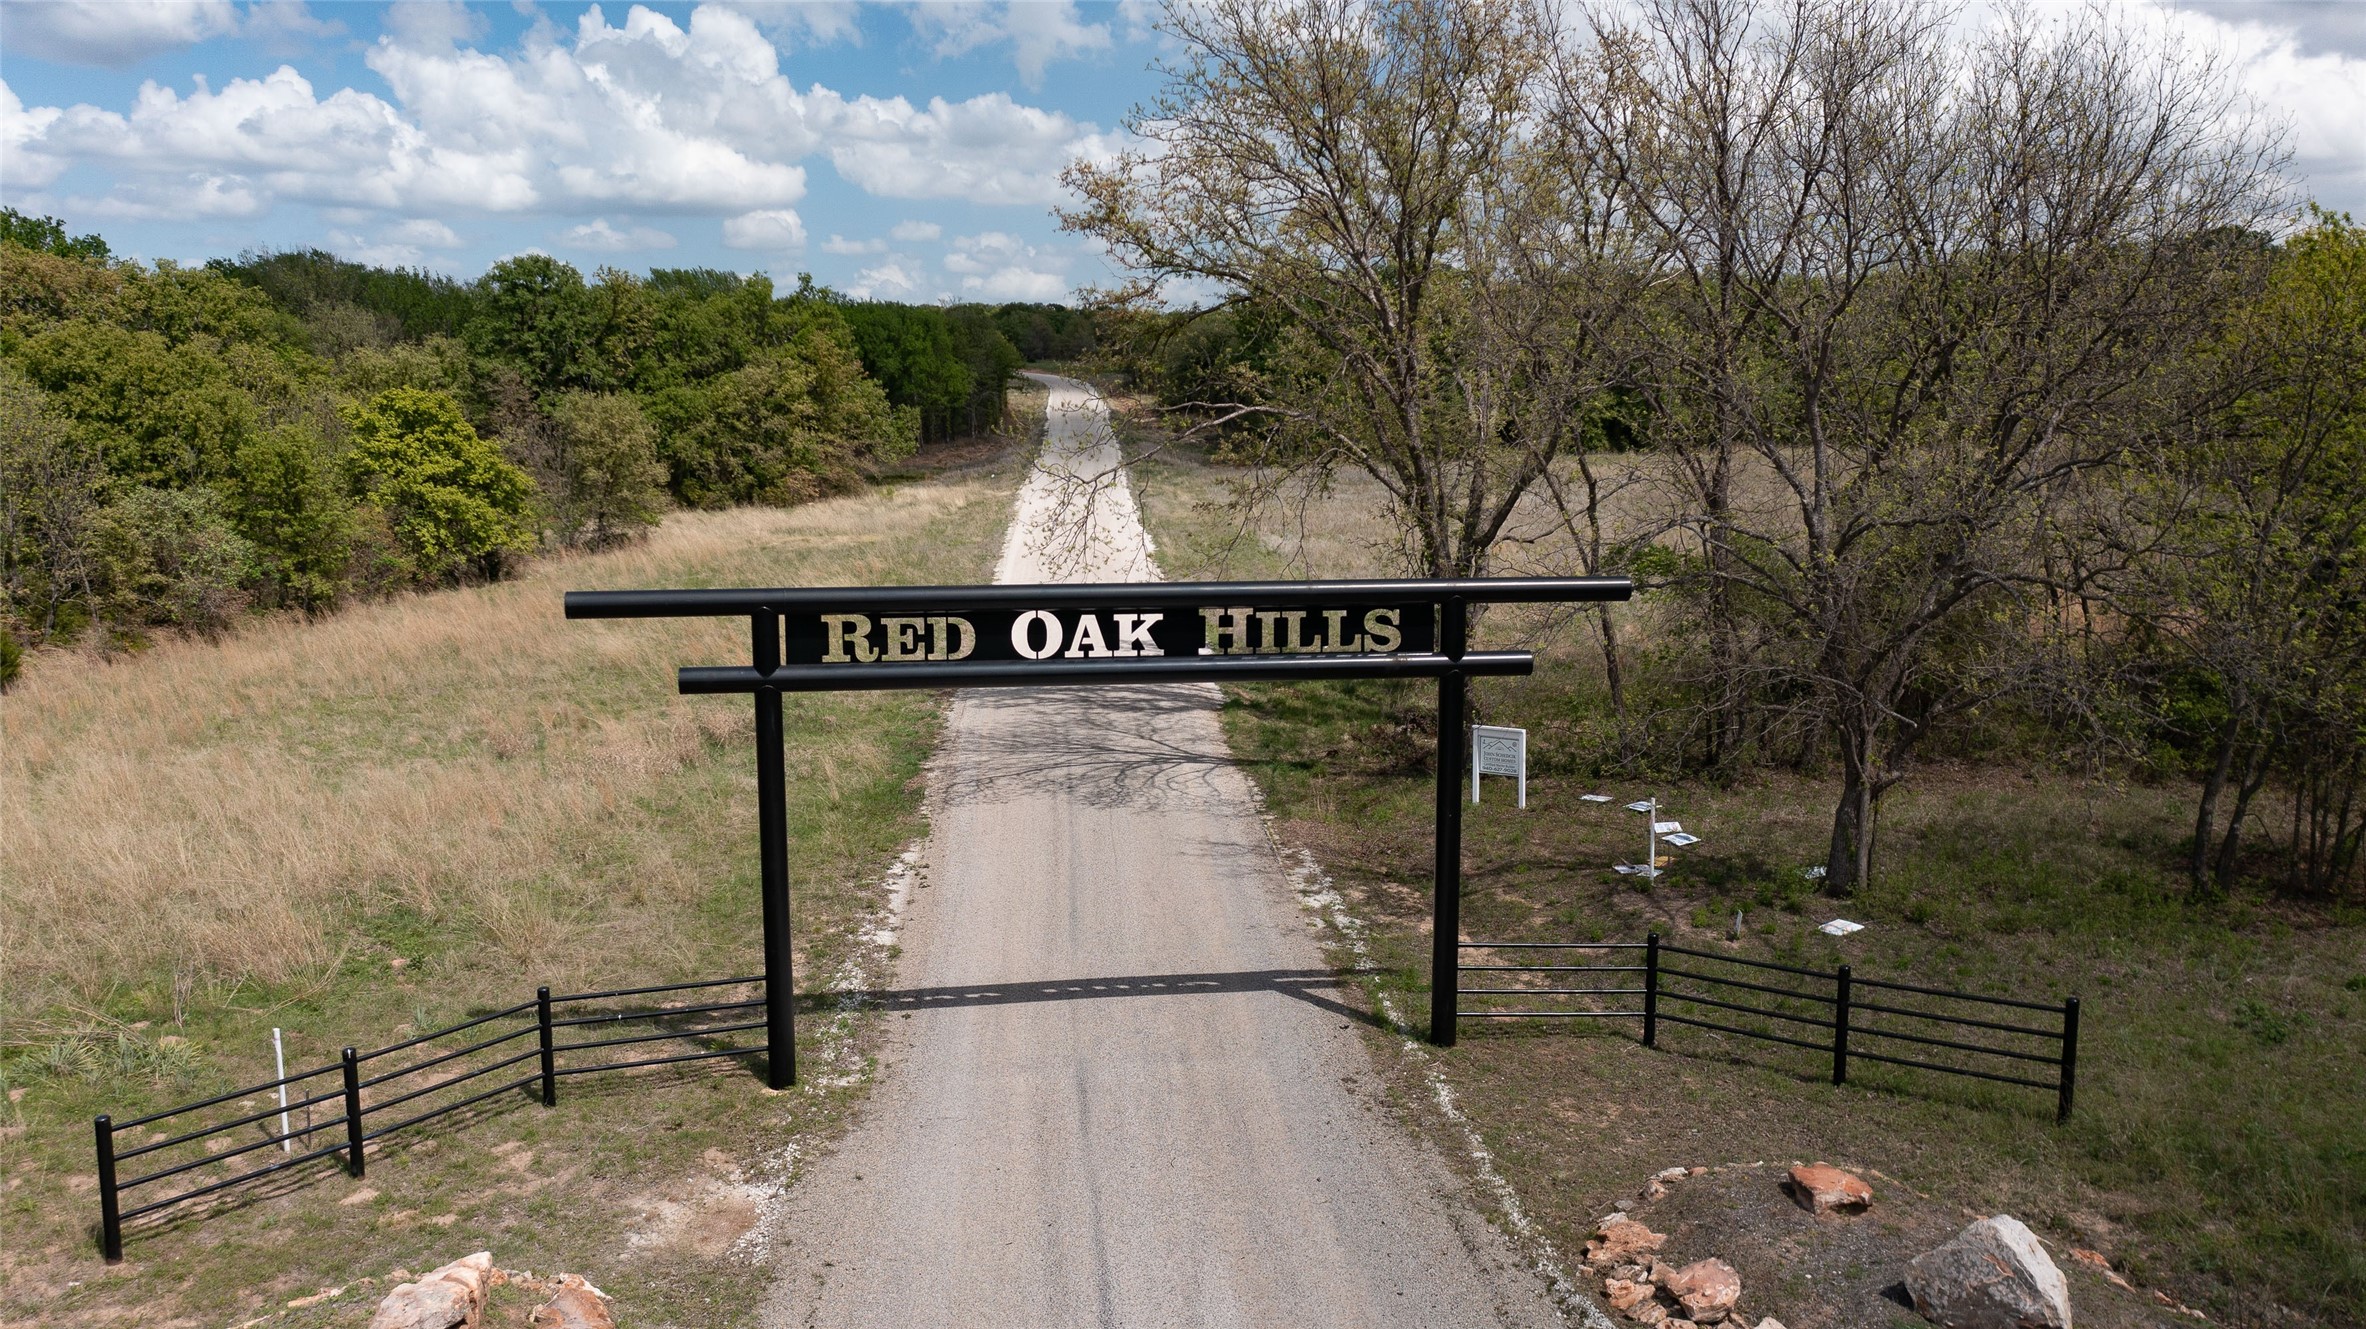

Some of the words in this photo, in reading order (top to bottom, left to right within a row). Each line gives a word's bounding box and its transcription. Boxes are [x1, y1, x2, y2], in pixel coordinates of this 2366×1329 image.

[820, 614, 976, 663] RED
[1011, 609, 1165, 660] OAK
[1198, 607, 1401, 655] HILLS
